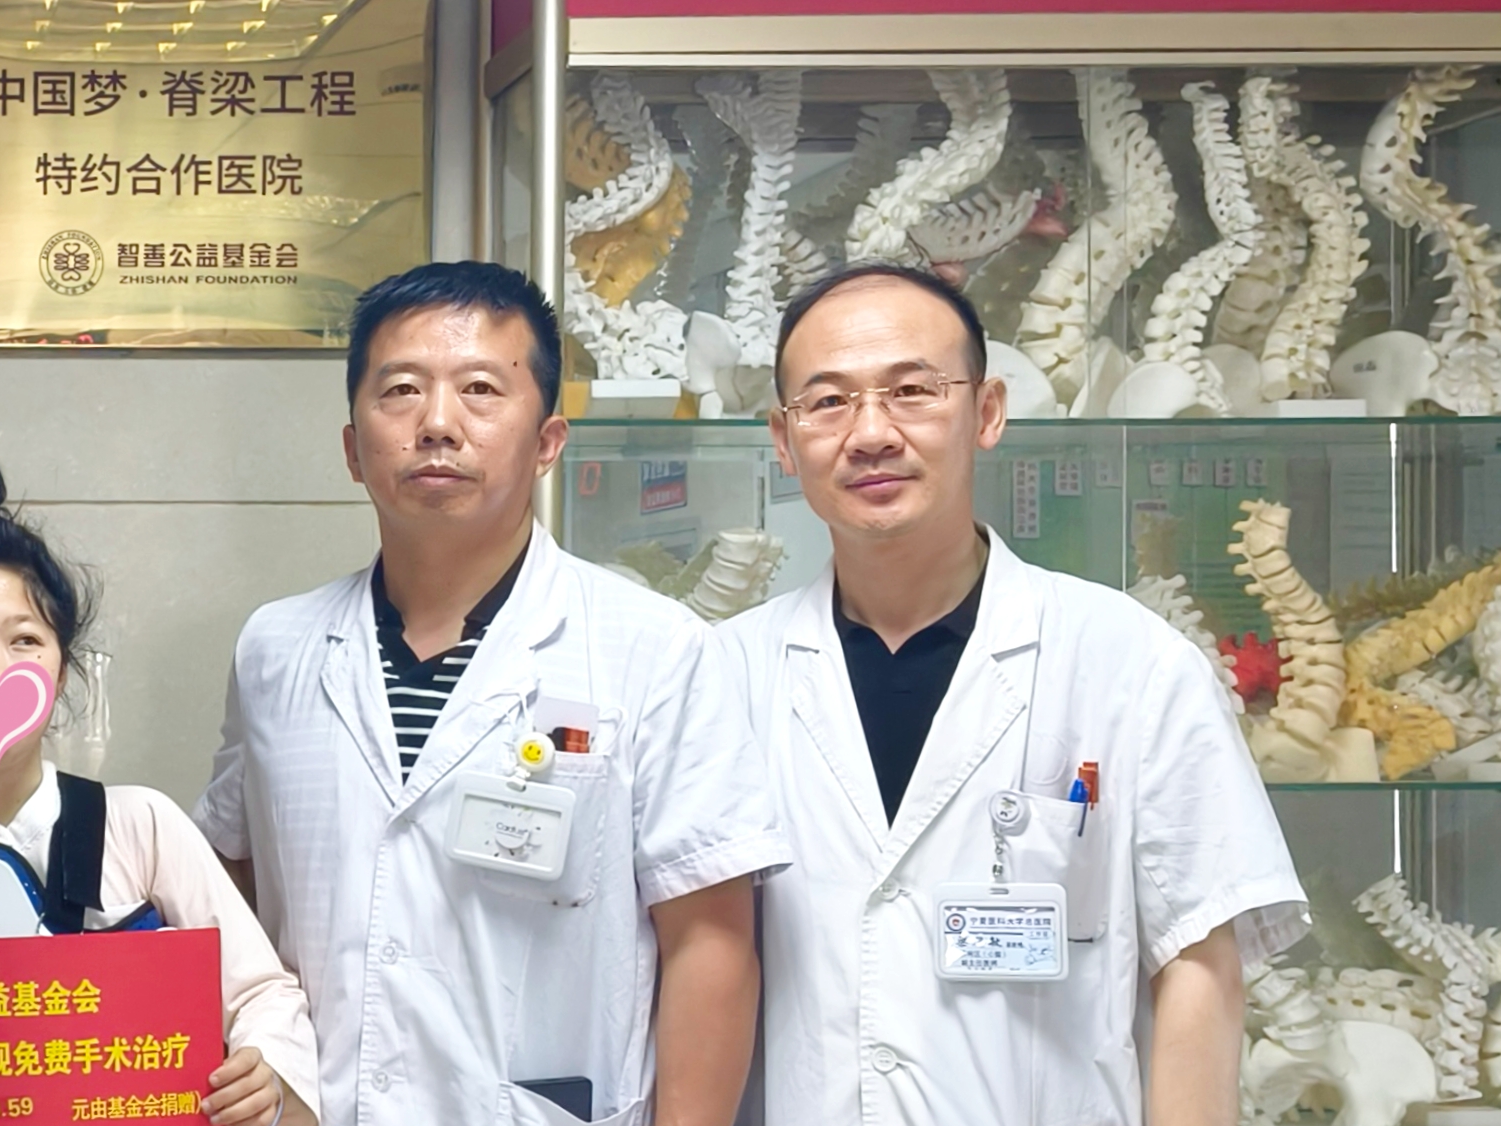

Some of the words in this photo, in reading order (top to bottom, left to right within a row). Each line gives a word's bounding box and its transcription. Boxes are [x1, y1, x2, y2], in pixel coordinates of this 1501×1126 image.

[35, 153, 303, 196] 特约合作医院
[117, 242, 299, 268] 智善公益基金会
[119, 275, 188, 285] ZHISHAN
[196, 275, 298, 285] FOUNDATION
